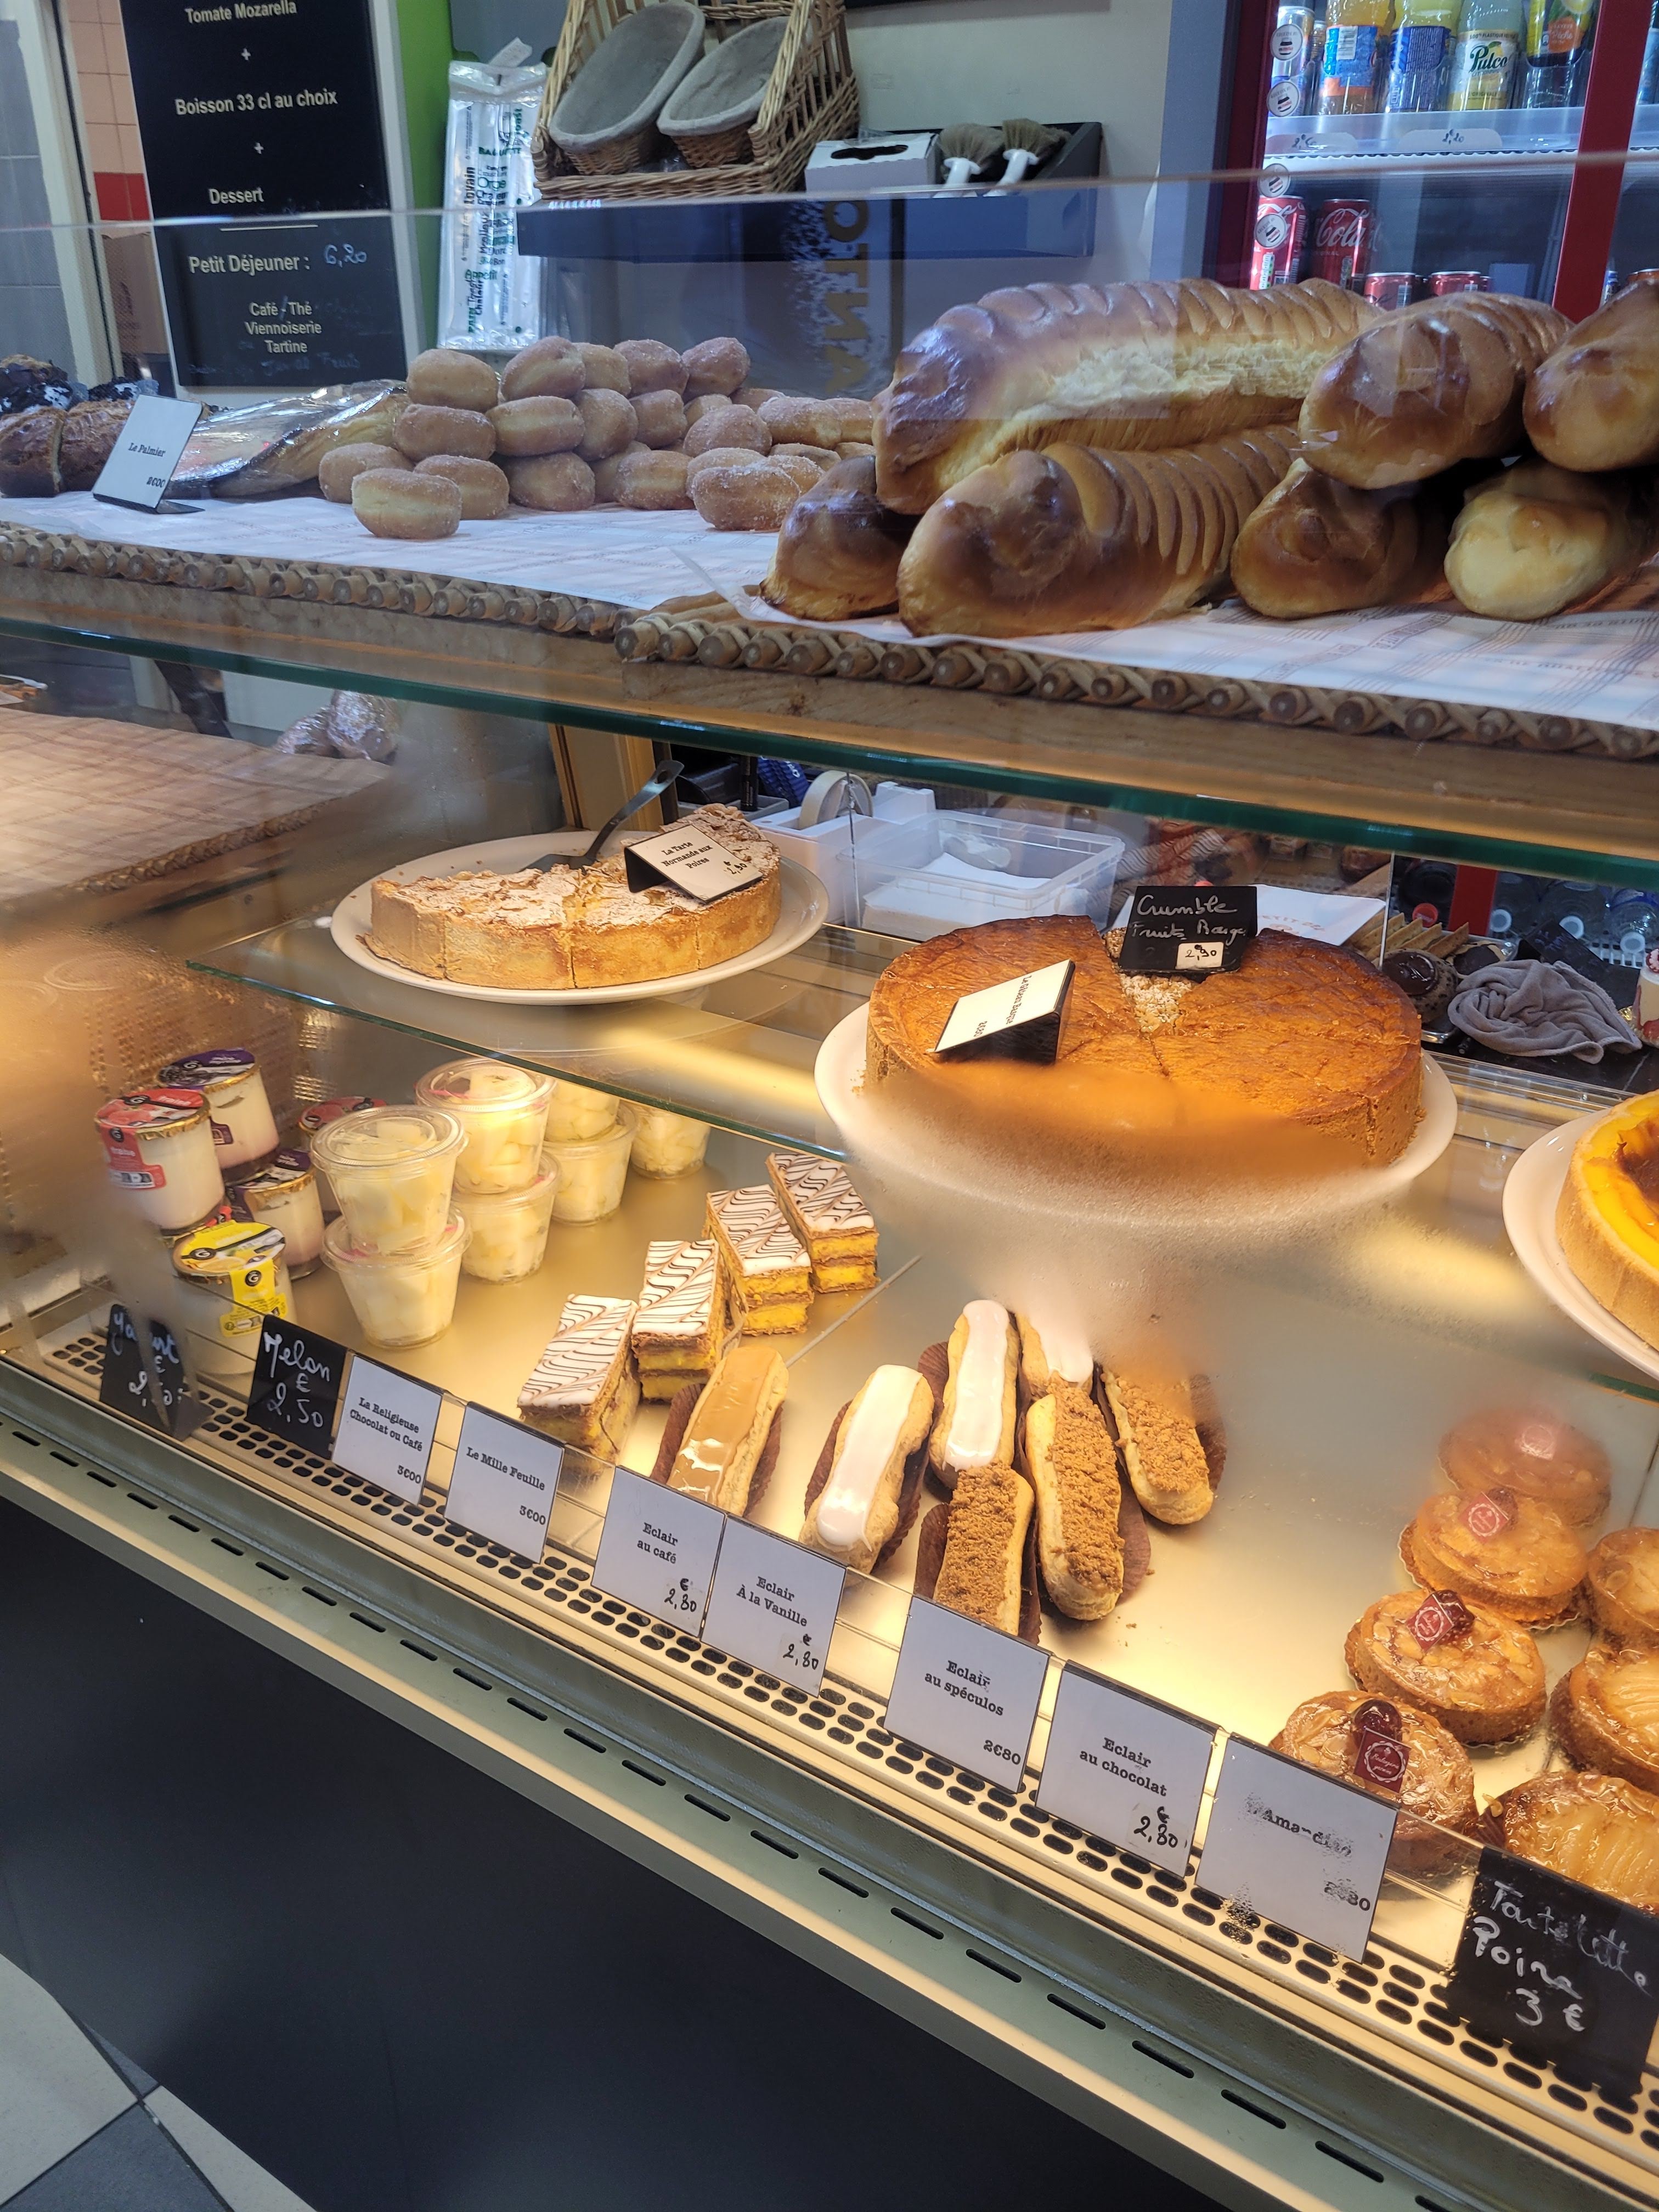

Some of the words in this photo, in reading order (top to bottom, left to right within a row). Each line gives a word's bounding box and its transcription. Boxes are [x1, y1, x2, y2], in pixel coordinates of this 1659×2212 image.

[184, 5, 232, 24] Tomate
[234, 0, 298, 19] Mozarella
[1469, 44, 1508, 74] Pulco
[174, 98, 234, 115] Boisson
[236, 93, 255, 111] 33
[257, 92, 272, 110] cl
[274, 94, 294, 109] au
[296, 87, 338, 107] choix
[208, 187, 264, 204] Dessert
[189, 255, 226, 274] Petit
[227, 254, 300, 276] Déjeuner
[249, 301, 279, 317] Café
[287, 301, 313, 316] Thé
[244, 320, 323, 336] Viennoiserie
[263, 339, 308, 354] Tartine
[128, 442, 138, 452] Le
[138, 444, 166, 457] Palmier
[661, 850, 699, 867] Normande
[699, 845, 713, 854] aux
[674, 842, 693, 853] Tarte
[685, 857, 710, 869] Poires
[1137, 894, 1238, 916] Crumble
[1021, 975, 1032, 984] Le
[1014, 983, 1029, 1004] Gâteau
[1006, 1002, 1022, 1024] Basque
[263, 1331, 330, 1381] Melon
[358, 1397, 371, 1410] La
[372, 1403, 420, 1434] Religieuse
[349, 1408, 389, 1435] Chocolat
[390, 1430, 402, 1441] ou
[402, 1435, 422, 1452] Café
[397, 1465, 422, 1485] 3€00
[466, 1447, 480, 1460] Le
[481, 1453, 514, 1475] Mille
[510, 1466, 545, 1491] Feuille
[519, 1505, 546, 1526] 3€00
[642, 1522, 678, 1547] Eclair
[637, 1539, 652, 1553] au
[653, 1545, 676, 1564] café
[756, 1576, 795, 1602] Eclair
[736, 1584, 747, 1599] À
[748, 1589, 761, 1606] la
[764, 1598, 808, 1627] Vanille
[946, 1660, 992, 1688] Eclair
[924, 1671, 942, 1688] au
[944, 1680, 1003, 1716] spéculos
[983, 1739, 1022, 1766] 2€80
[1102, 1737, 1152, 1768] Eclair
[1079, 1748, 1098, 1765] au
[1102, 1759, 1167, 1797] chocolat
[1515, 1988, 1543, 2026] 3
[1563, 2004, 1585, 2032] €
